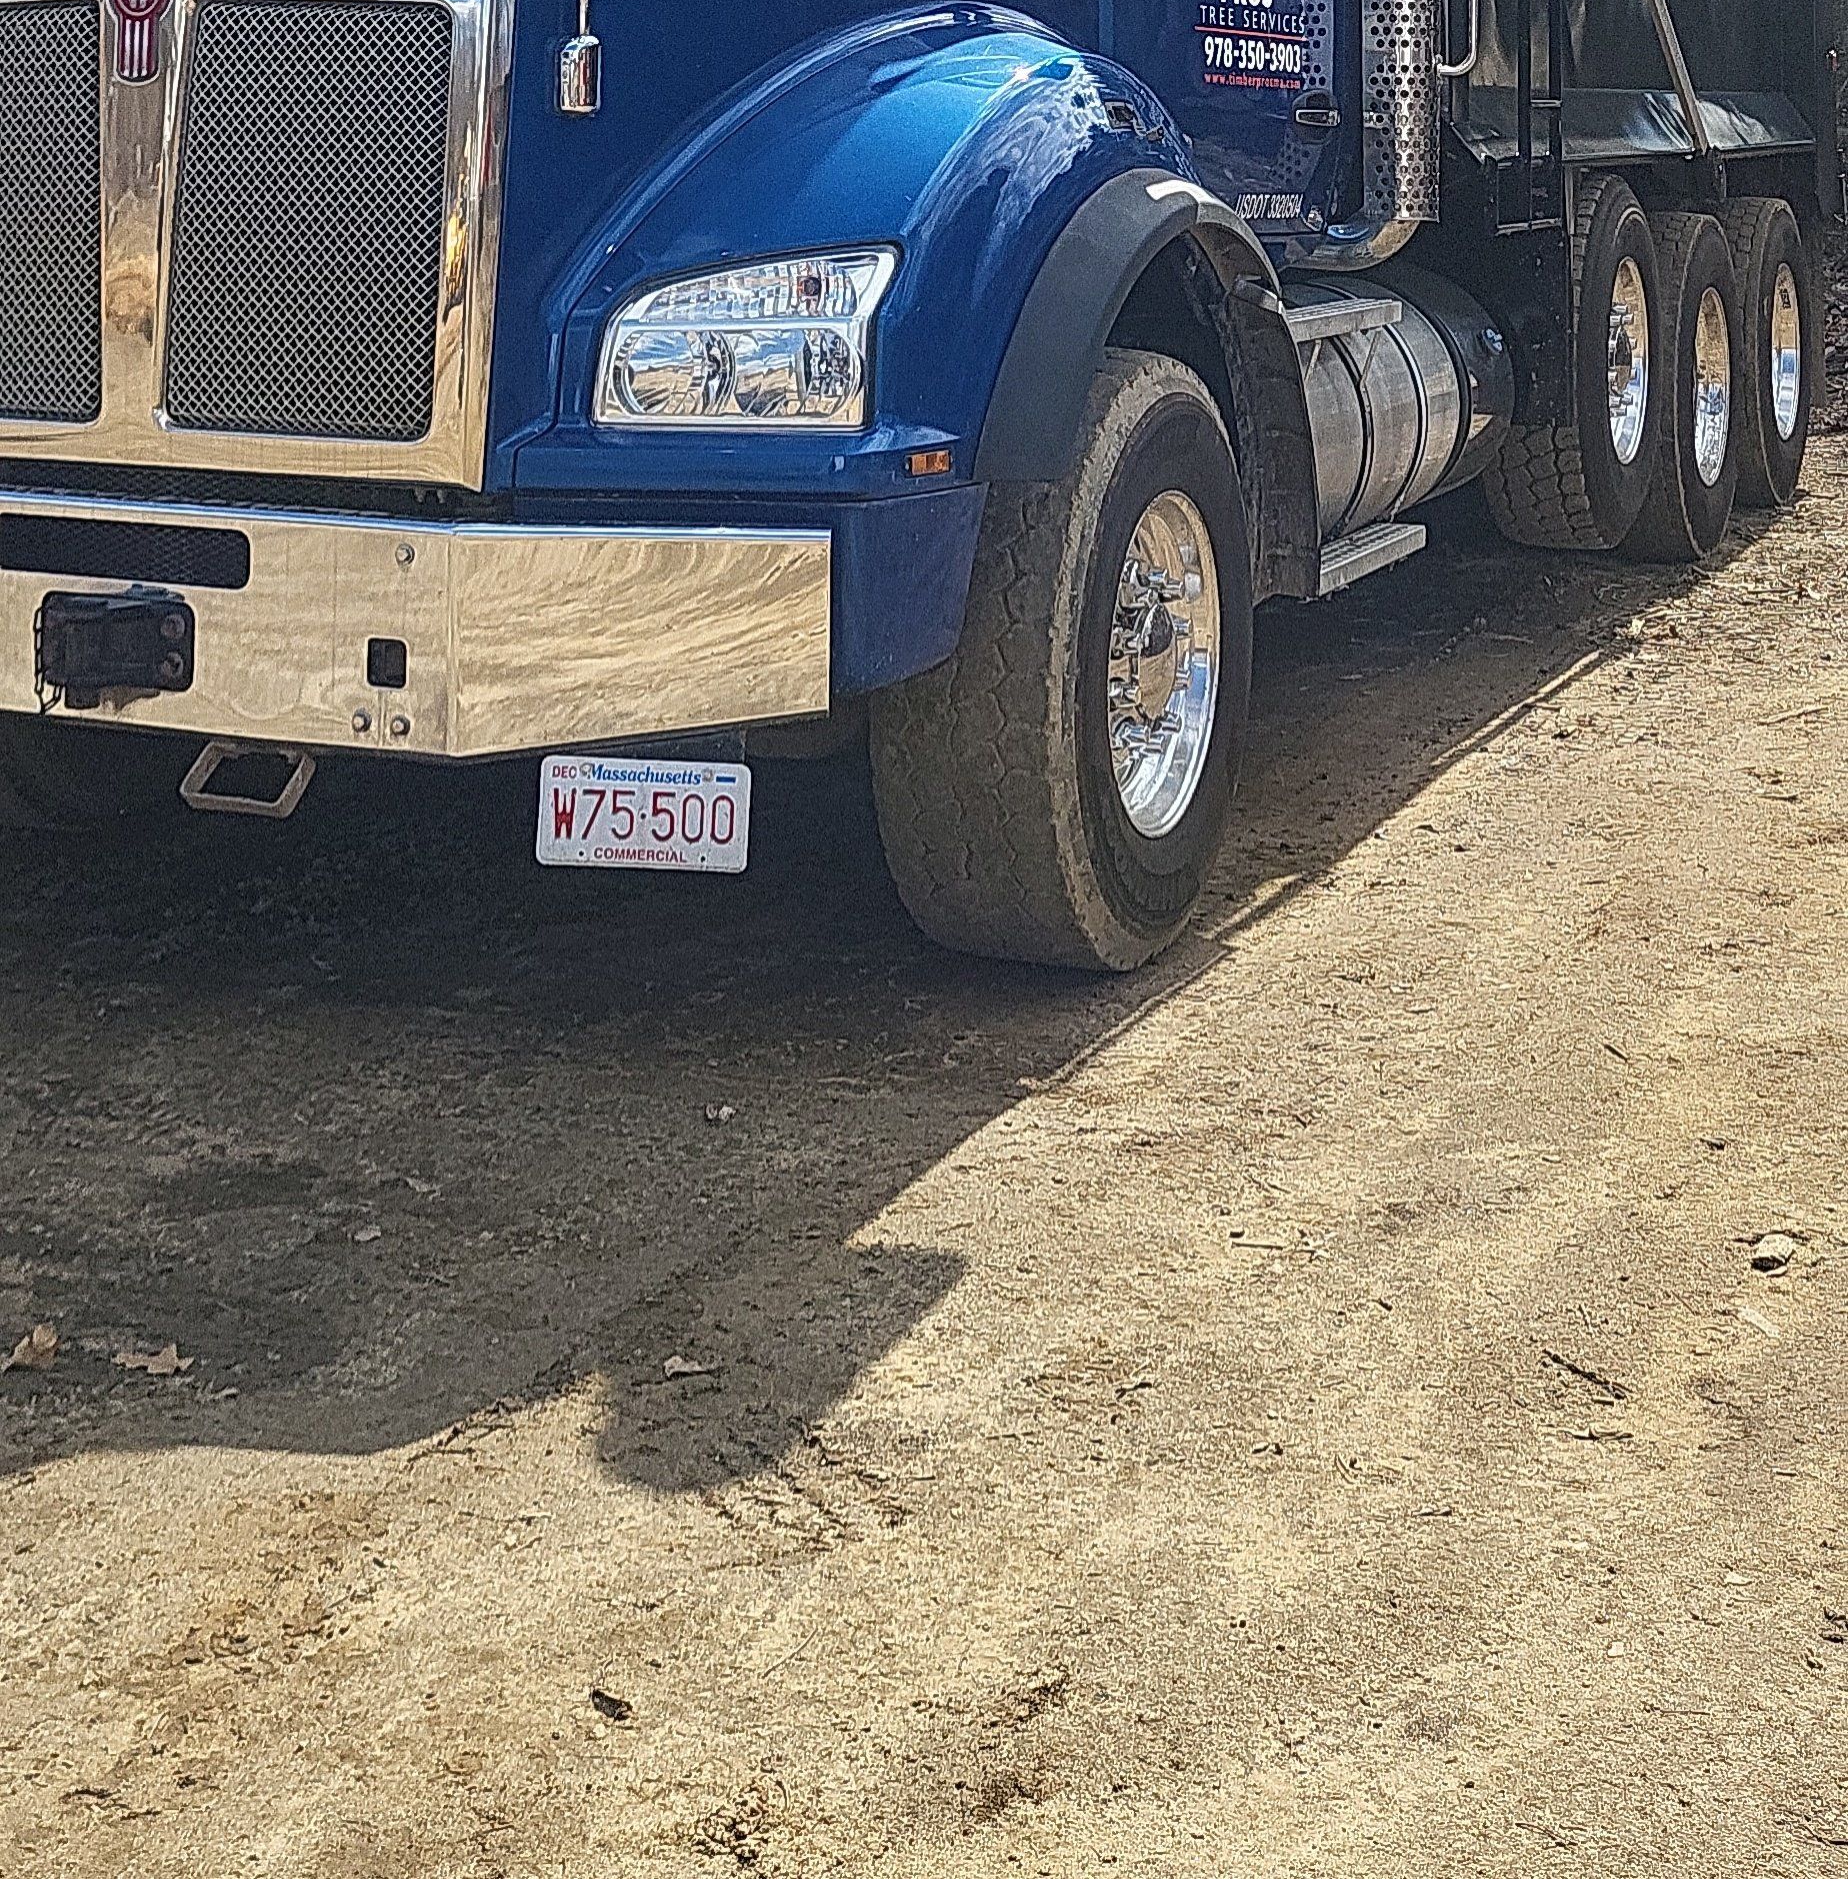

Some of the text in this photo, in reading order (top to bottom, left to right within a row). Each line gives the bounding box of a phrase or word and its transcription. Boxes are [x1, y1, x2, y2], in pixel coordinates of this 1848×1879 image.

[1200, 5, 1305, 34] TREE SERVICES
[1204, 36, 1301, 73] 978-350-3903
[1235, 193, 1270, 219] USDOT
[552, 763, 701, 786] DEC Massachusetts
[593, 847, 687, 864] COMMERCIAL
